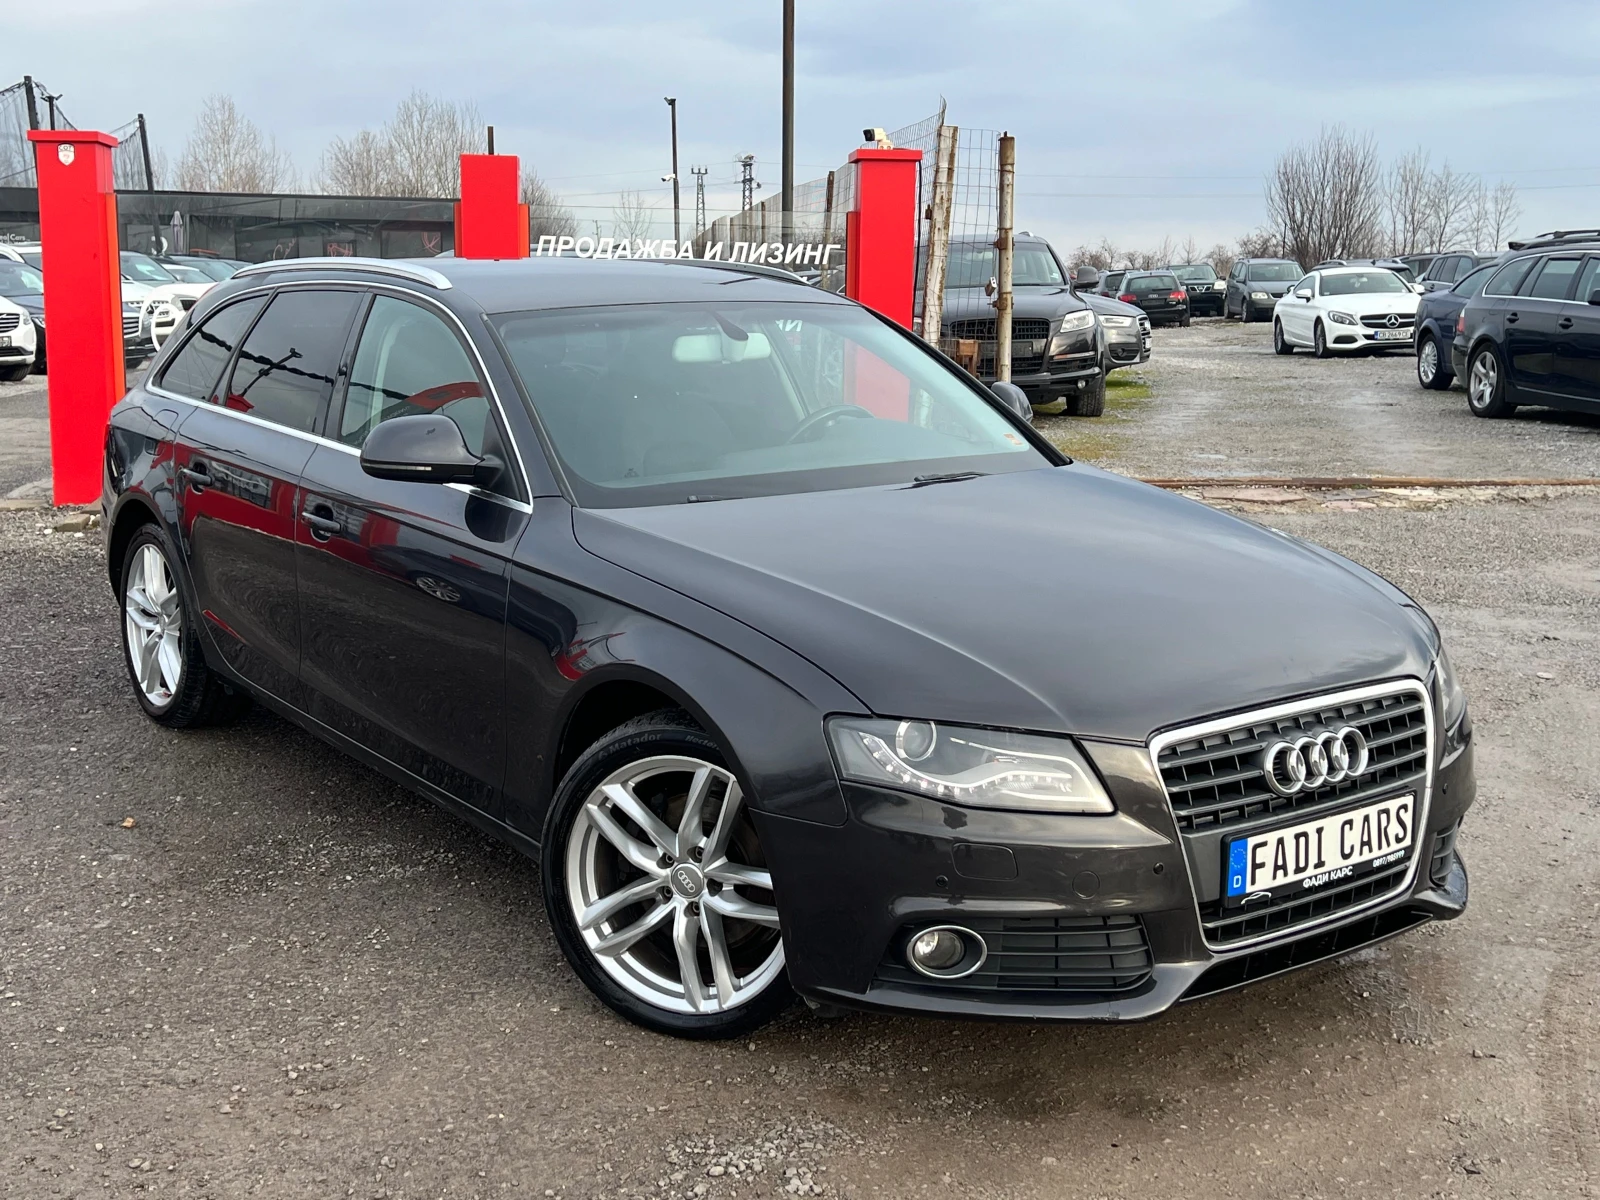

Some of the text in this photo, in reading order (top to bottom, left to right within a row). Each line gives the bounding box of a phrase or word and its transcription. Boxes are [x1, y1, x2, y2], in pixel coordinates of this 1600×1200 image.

[536, 235, 842, 265] ПРОДАЖБА И ЛИЗИНГ
[608, 732, 662, 754] Matador
[1250, 803, 1409, 886] FADI CARS
[1233, 875, 1242, 888] D
[1302, 865, 1353, 889] ФАДИ КАРС
